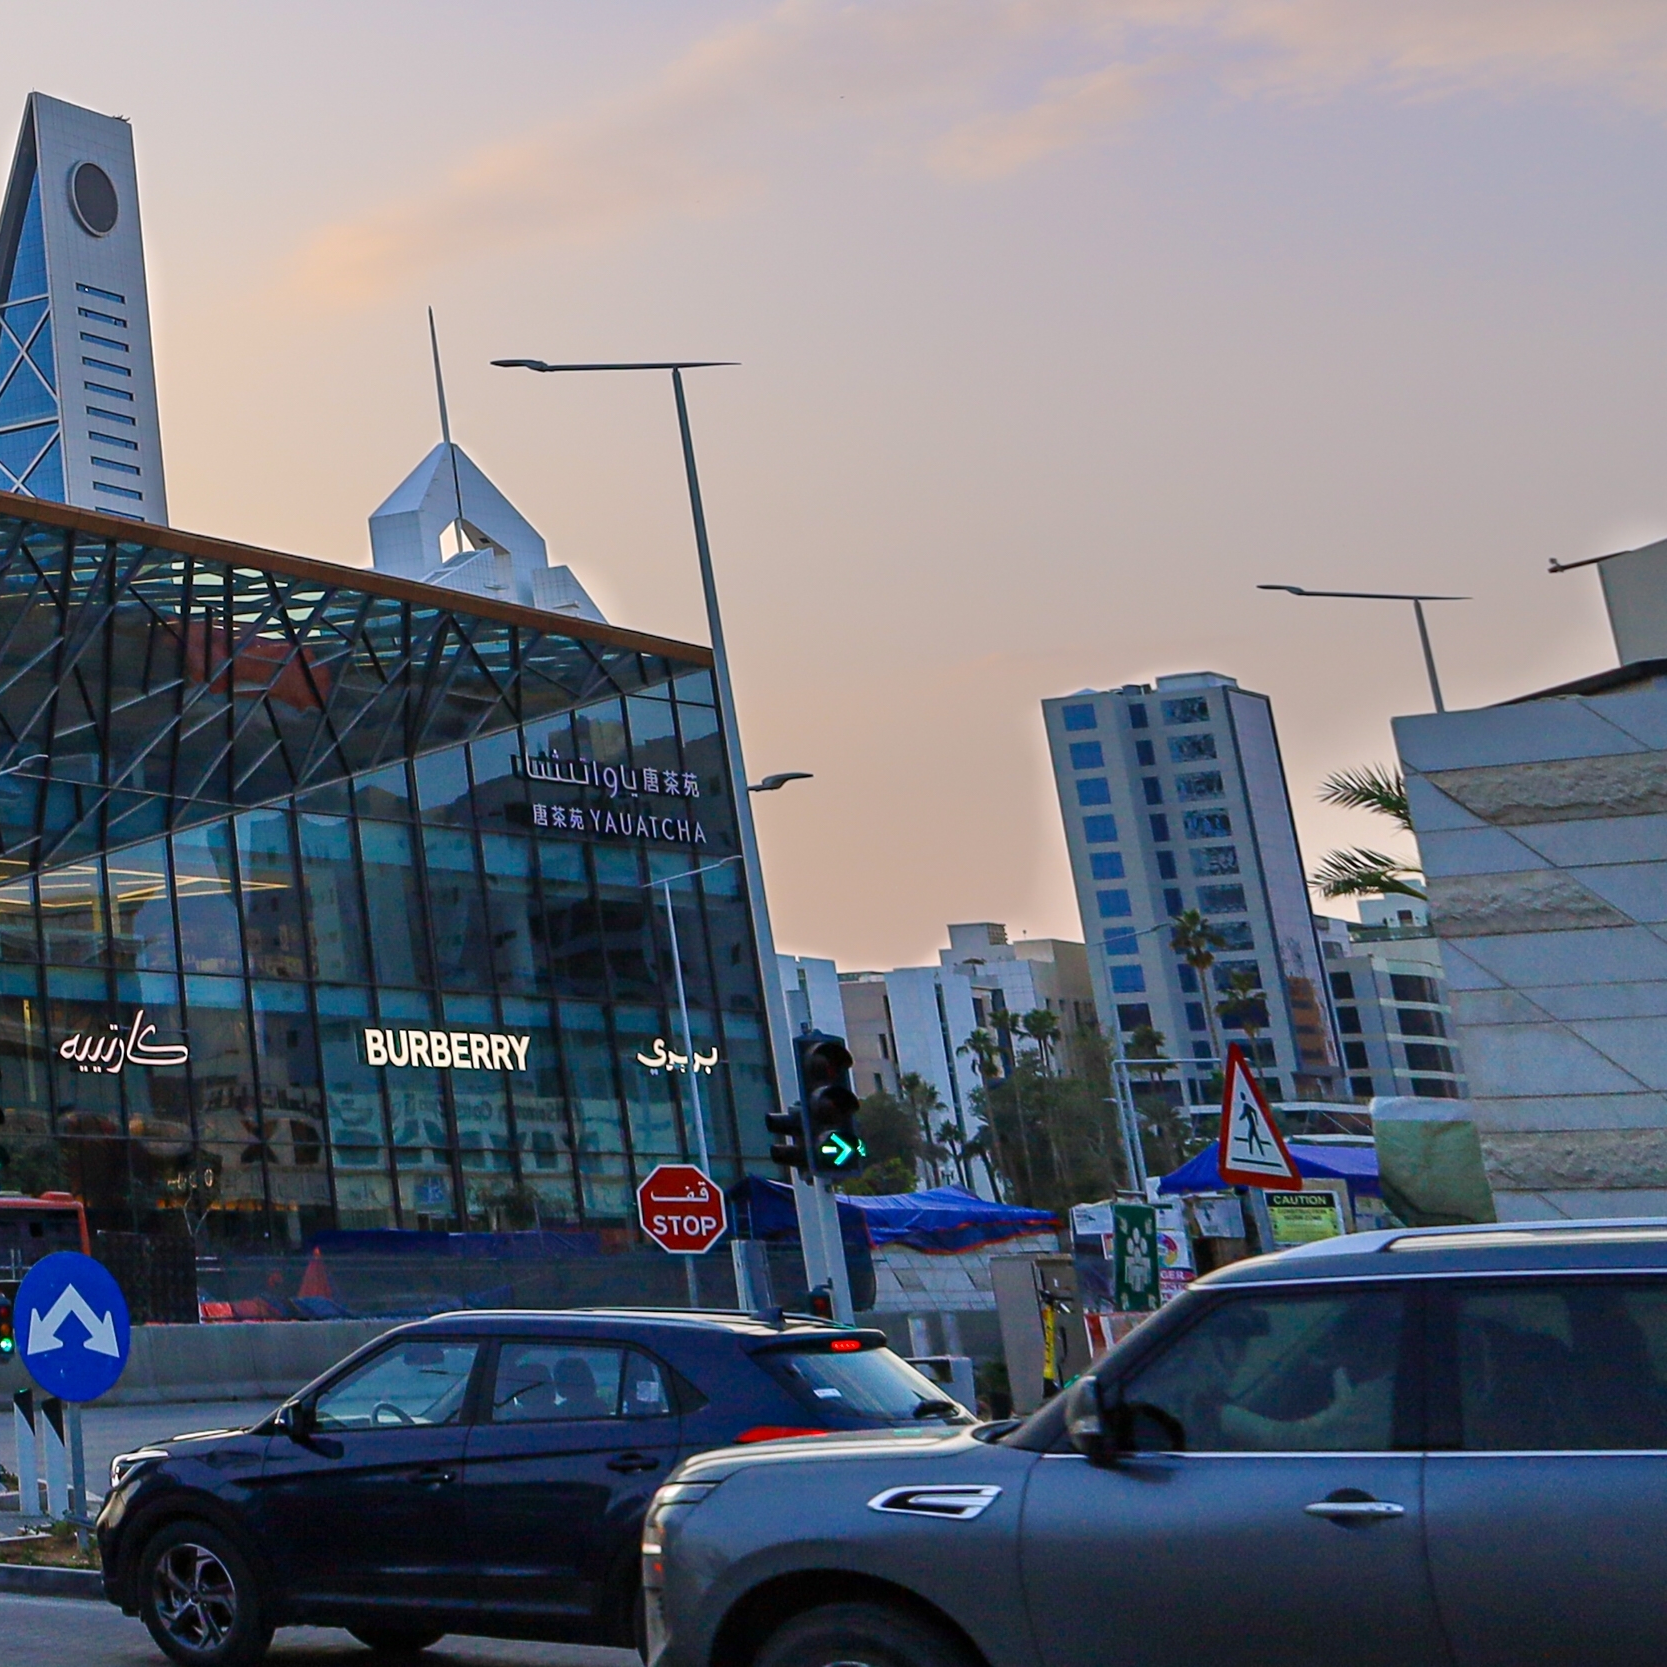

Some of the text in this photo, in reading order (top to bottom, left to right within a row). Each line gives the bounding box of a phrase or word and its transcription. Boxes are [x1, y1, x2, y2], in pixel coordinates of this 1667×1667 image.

[643, 767, 700, 798] 唐茶苑
[533, 803, 584, 830] 唐茶苑
[589, 808, 707, 844] YAUATCHA
[364, 1029, 530, 1071] BURBERRY
[651, 1181, 709, 1202] قف
[1273, 1195, 1327, 1205] CAUTION
[653, 1214, 717, 1236] STOP
